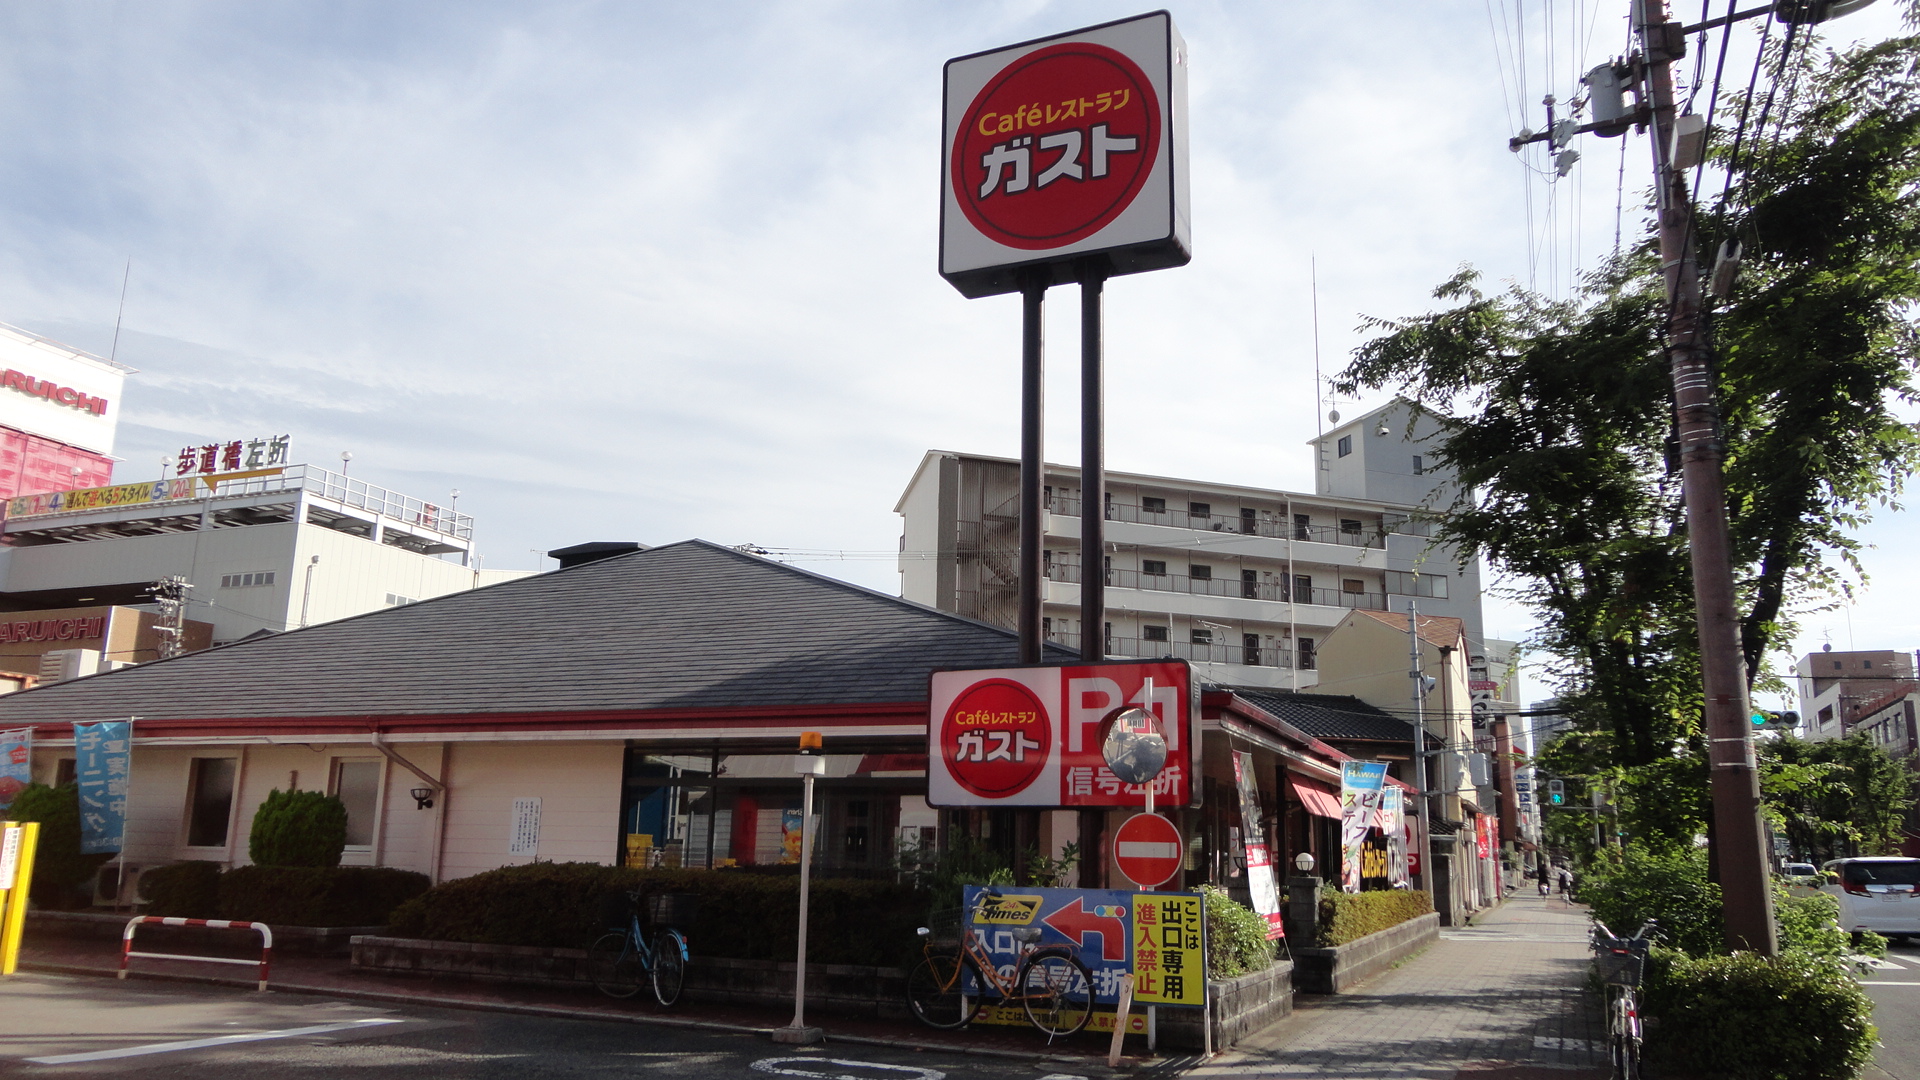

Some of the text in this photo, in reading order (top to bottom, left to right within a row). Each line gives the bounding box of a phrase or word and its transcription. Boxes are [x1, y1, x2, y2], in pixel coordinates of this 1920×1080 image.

[980, 125, 1136, 198] ガスト
[0, 368, 107, 415] RUICHI
[177, 434, 291, 475] 歩道橋左折
[1069, 677, 1124, 752] P
[956, 729, 1039, 762] ガスト
[1136, 902, 1157, 995] 進入禁止
[1162, 900, 1184, 1000] 出口専用
[1185, 901, 1199, 950] ここは
